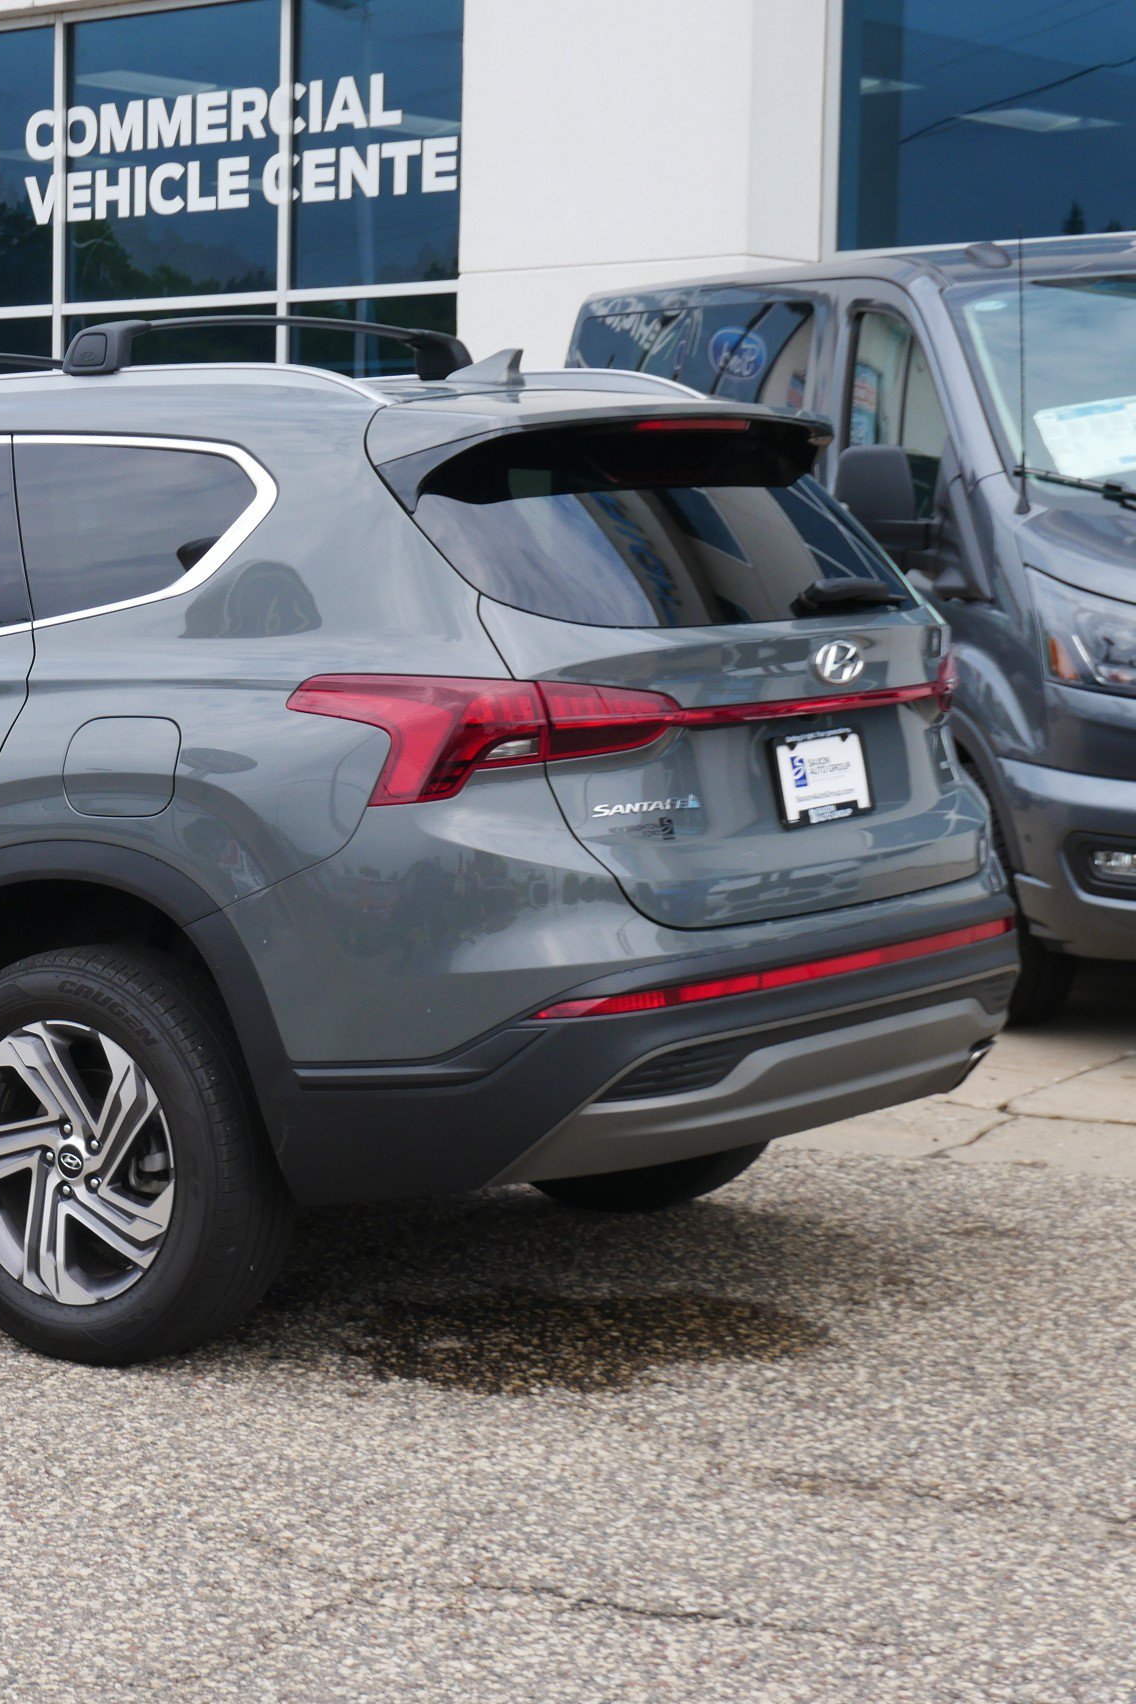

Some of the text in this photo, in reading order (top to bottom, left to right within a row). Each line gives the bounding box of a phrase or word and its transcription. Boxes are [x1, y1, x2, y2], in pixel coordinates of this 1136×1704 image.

[25, 72, 402, 161] COMMERCIAL
[25, 155, 250, 226] VEHICLE
[592, 800, 665, 818] SANTA
[58, 980, 160, 1047] CRUGEN
